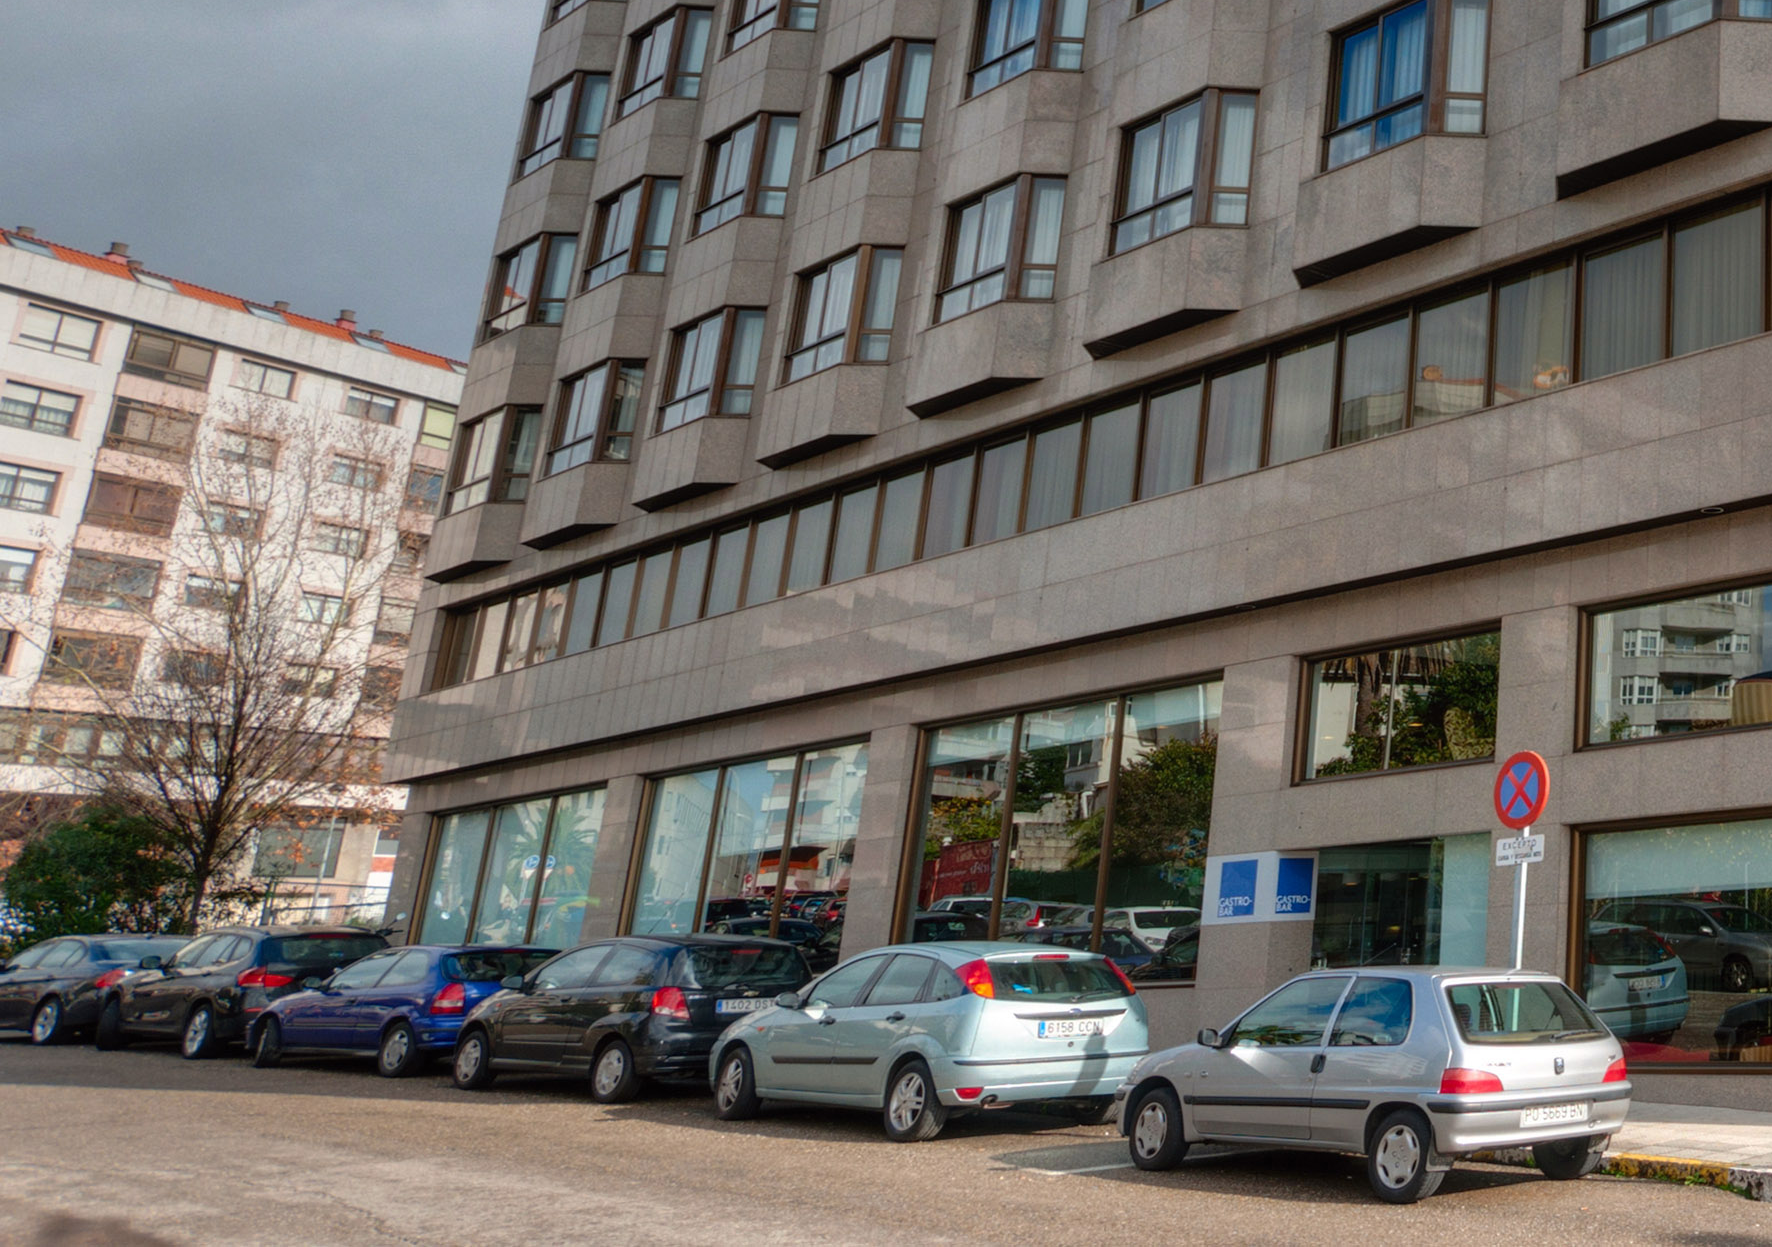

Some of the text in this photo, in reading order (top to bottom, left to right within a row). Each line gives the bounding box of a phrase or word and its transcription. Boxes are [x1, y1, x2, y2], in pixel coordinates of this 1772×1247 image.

[1219, 896, 1253, 907] GASTRO-
[1276, 895, 1311, 906] GASTRO-
[1218, 906, 1234, 916] BAR
[1275, 903, 1292, 912] BAR
[1047, 1020, 1100, 1033] 6158 CCN
